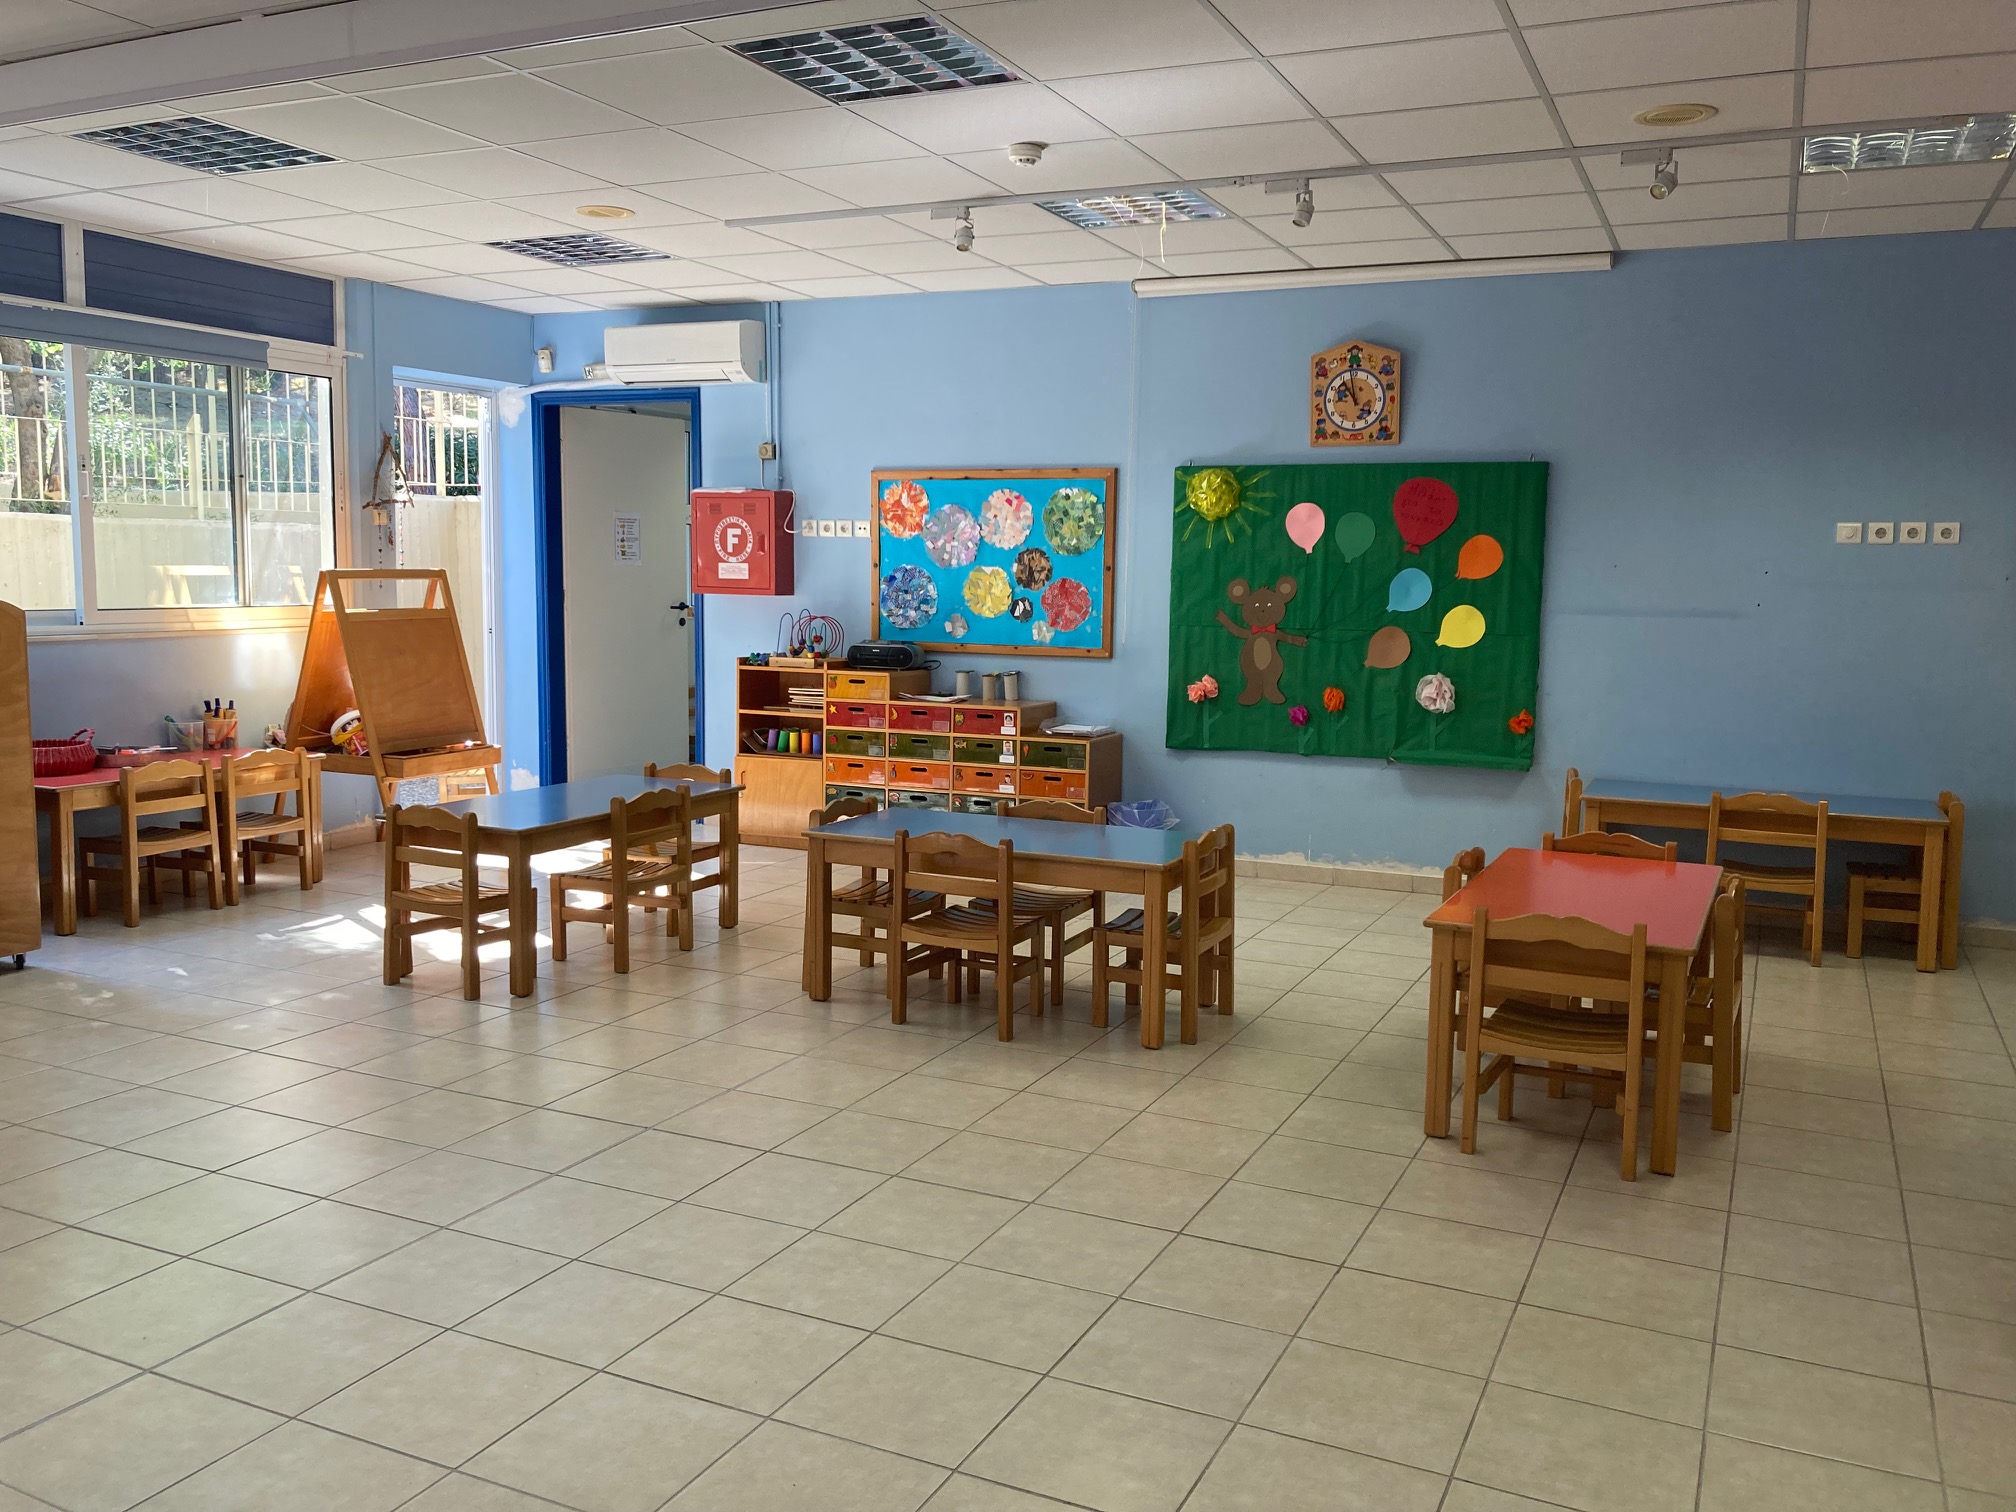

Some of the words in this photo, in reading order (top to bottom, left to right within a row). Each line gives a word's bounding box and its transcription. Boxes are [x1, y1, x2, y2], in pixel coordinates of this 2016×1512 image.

[727, 528, 742, 553] F
[718, 549, 731, 562] FIRE
[735, 549, 750, 562] HOSE
